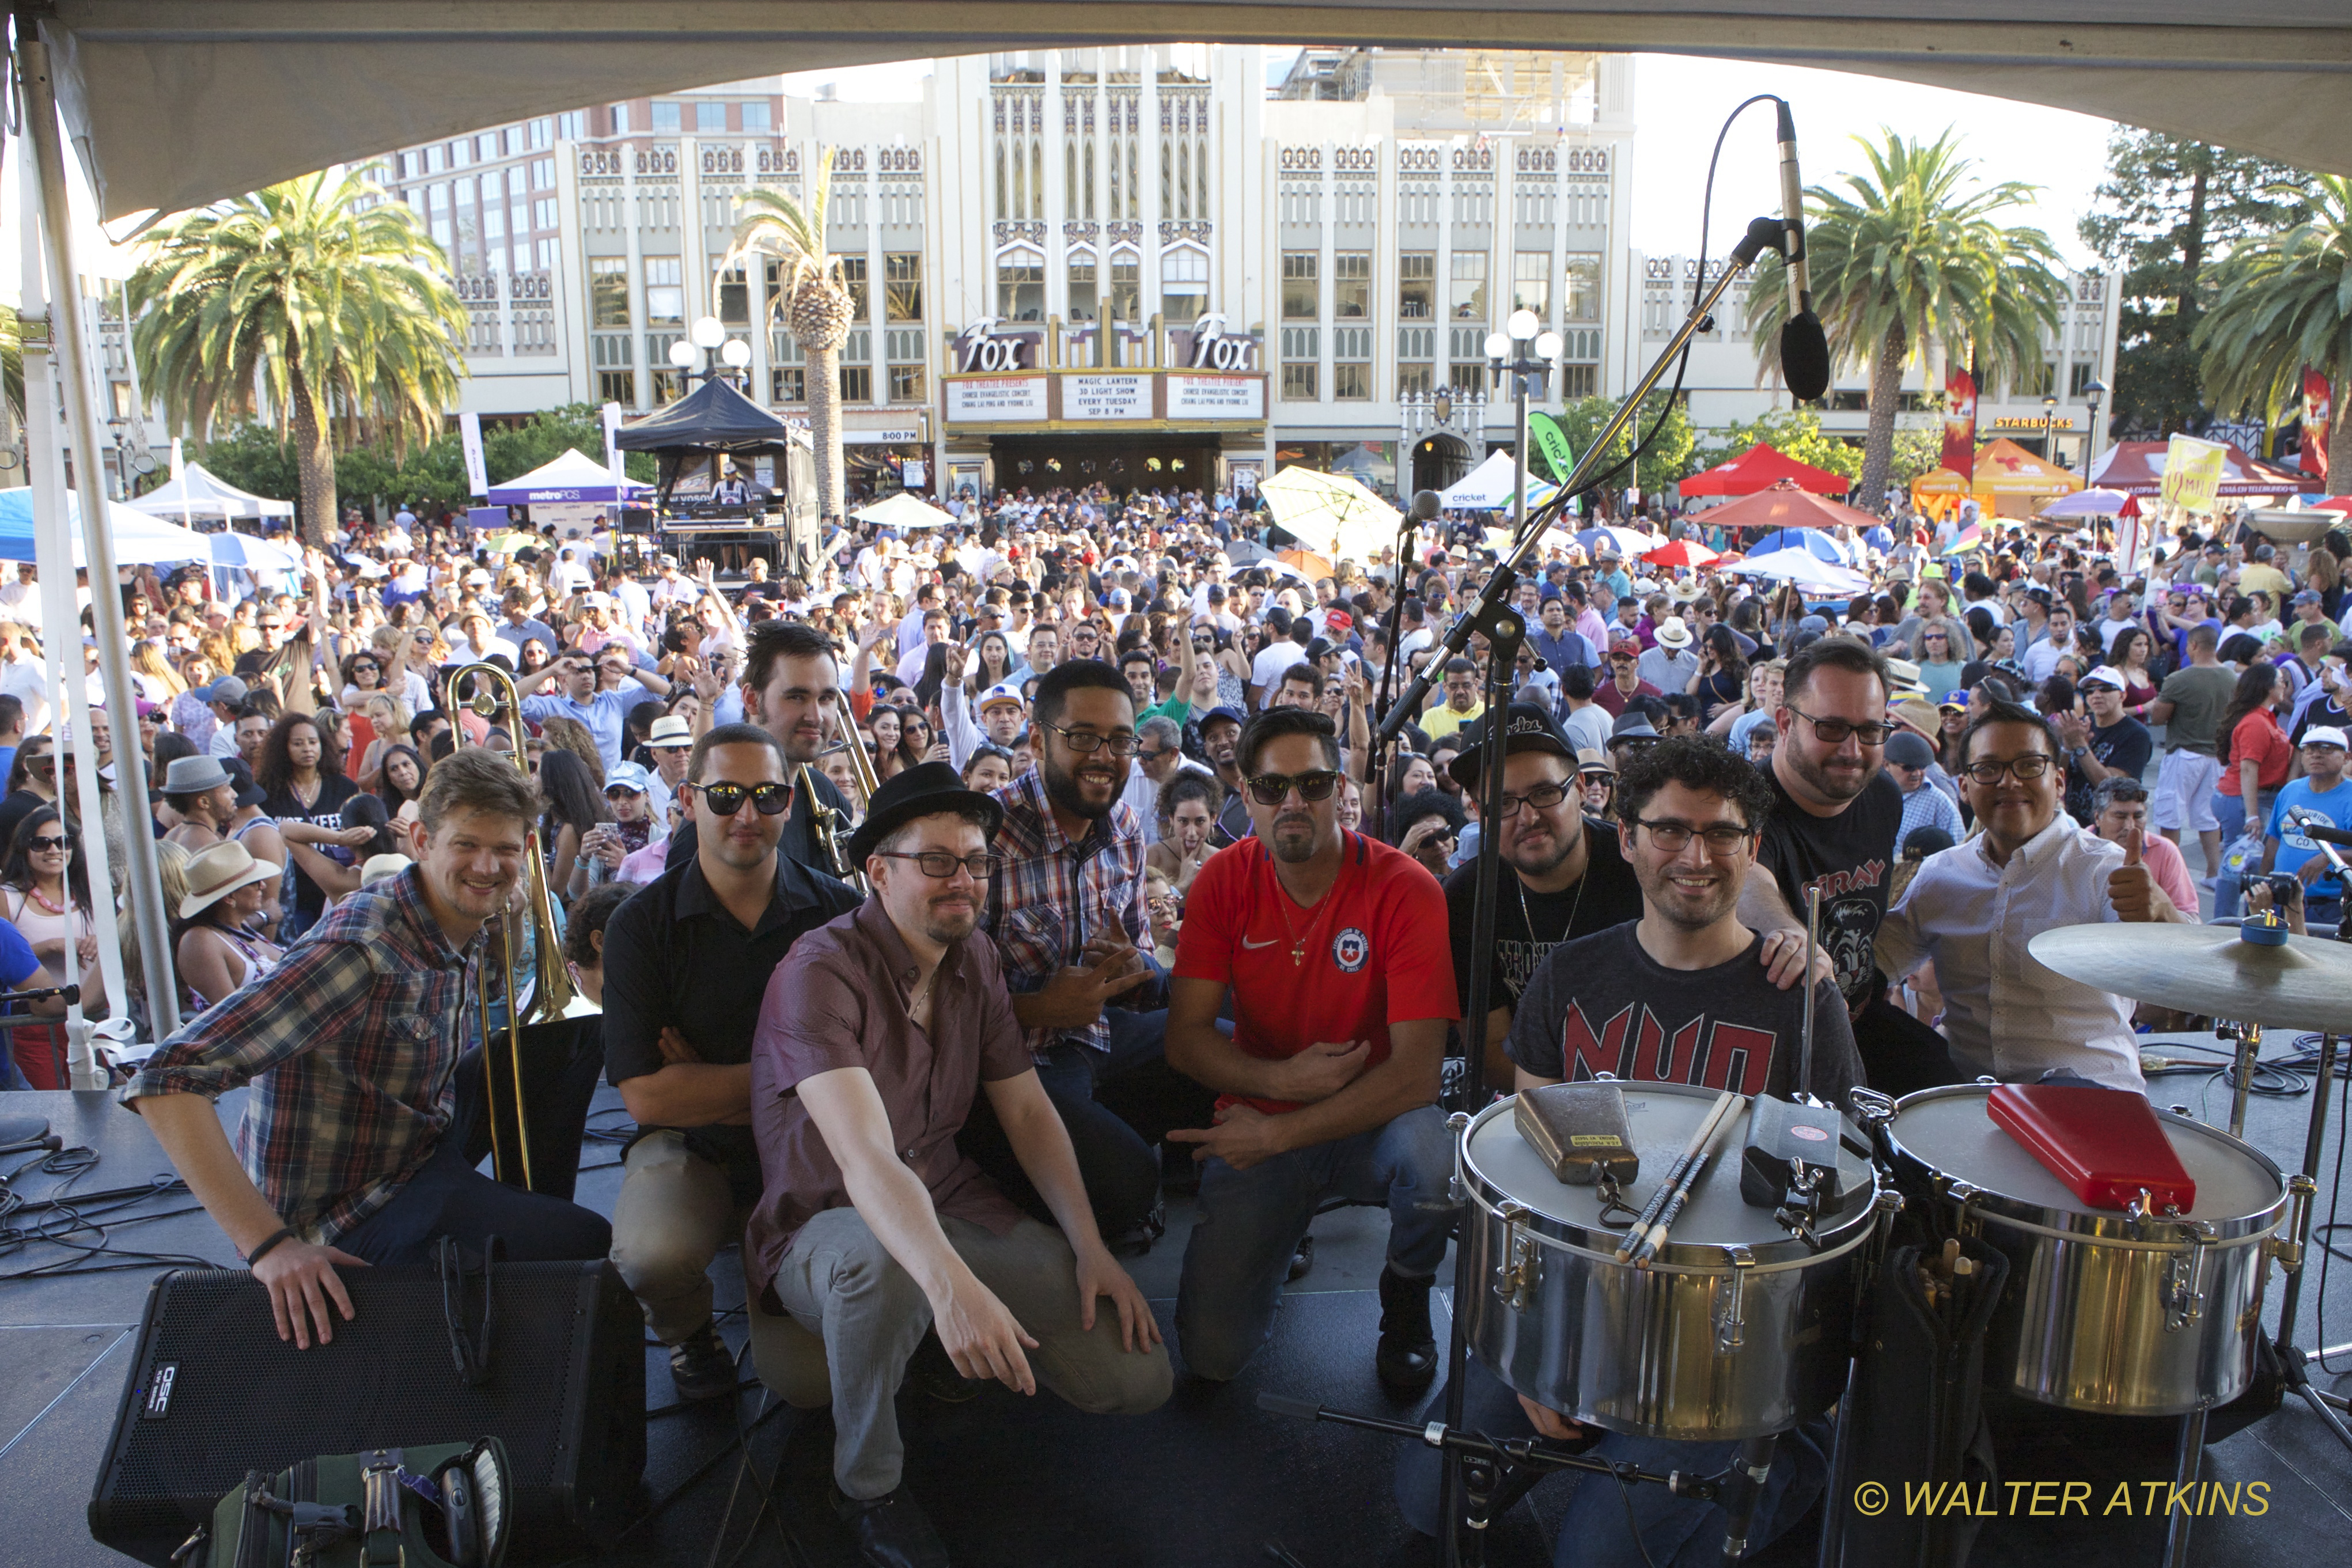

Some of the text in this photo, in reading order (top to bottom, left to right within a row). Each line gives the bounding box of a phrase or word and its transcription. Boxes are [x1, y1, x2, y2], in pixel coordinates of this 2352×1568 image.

[976, 380, 999, 388] THEATRE
[1002, 379, 1029, 388] PRESENTS
[1198, 377, 1221, 386] THEATRE
[1223, 378, 1247, 387] PRESENTS
[1995, 417, 2074, 429] STARBUCKS
[1801, 858, 1886, 907] STRAY
[149, 1370, 163, 1409] KW SERIES
[155, 1366, 175, 1411] QSC
